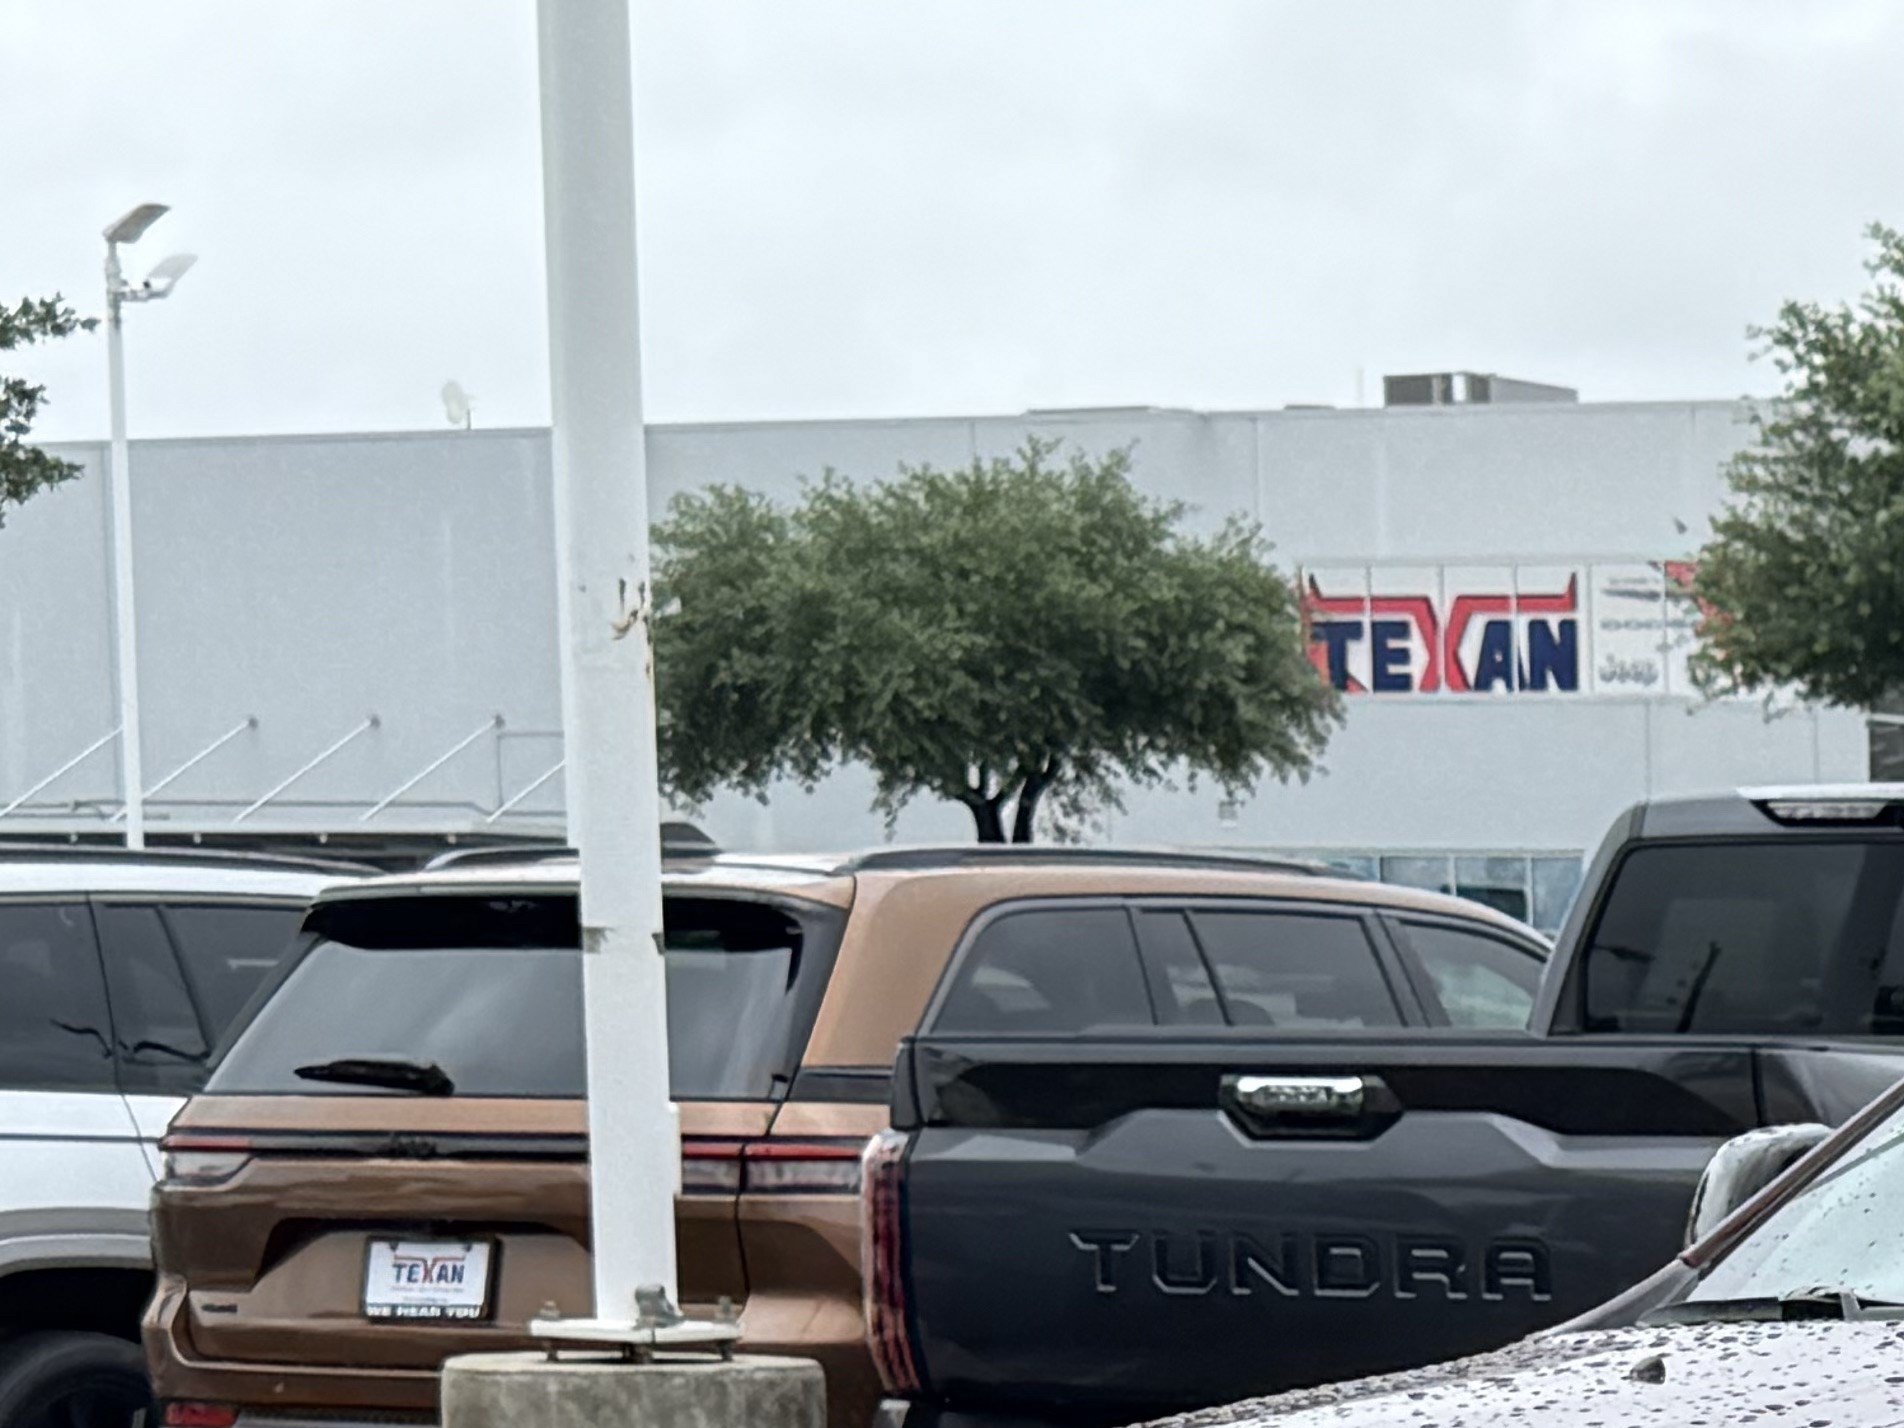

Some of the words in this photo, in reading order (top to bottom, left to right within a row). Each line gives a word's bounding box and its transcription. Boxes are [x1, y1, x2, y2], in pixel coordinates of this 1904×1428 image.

[1310, 595, 1580, 693] TEXAN
[392, 1256, 465, 1283] TEXAN
[1067, 1229, 1554, 1302] TUNDRA
